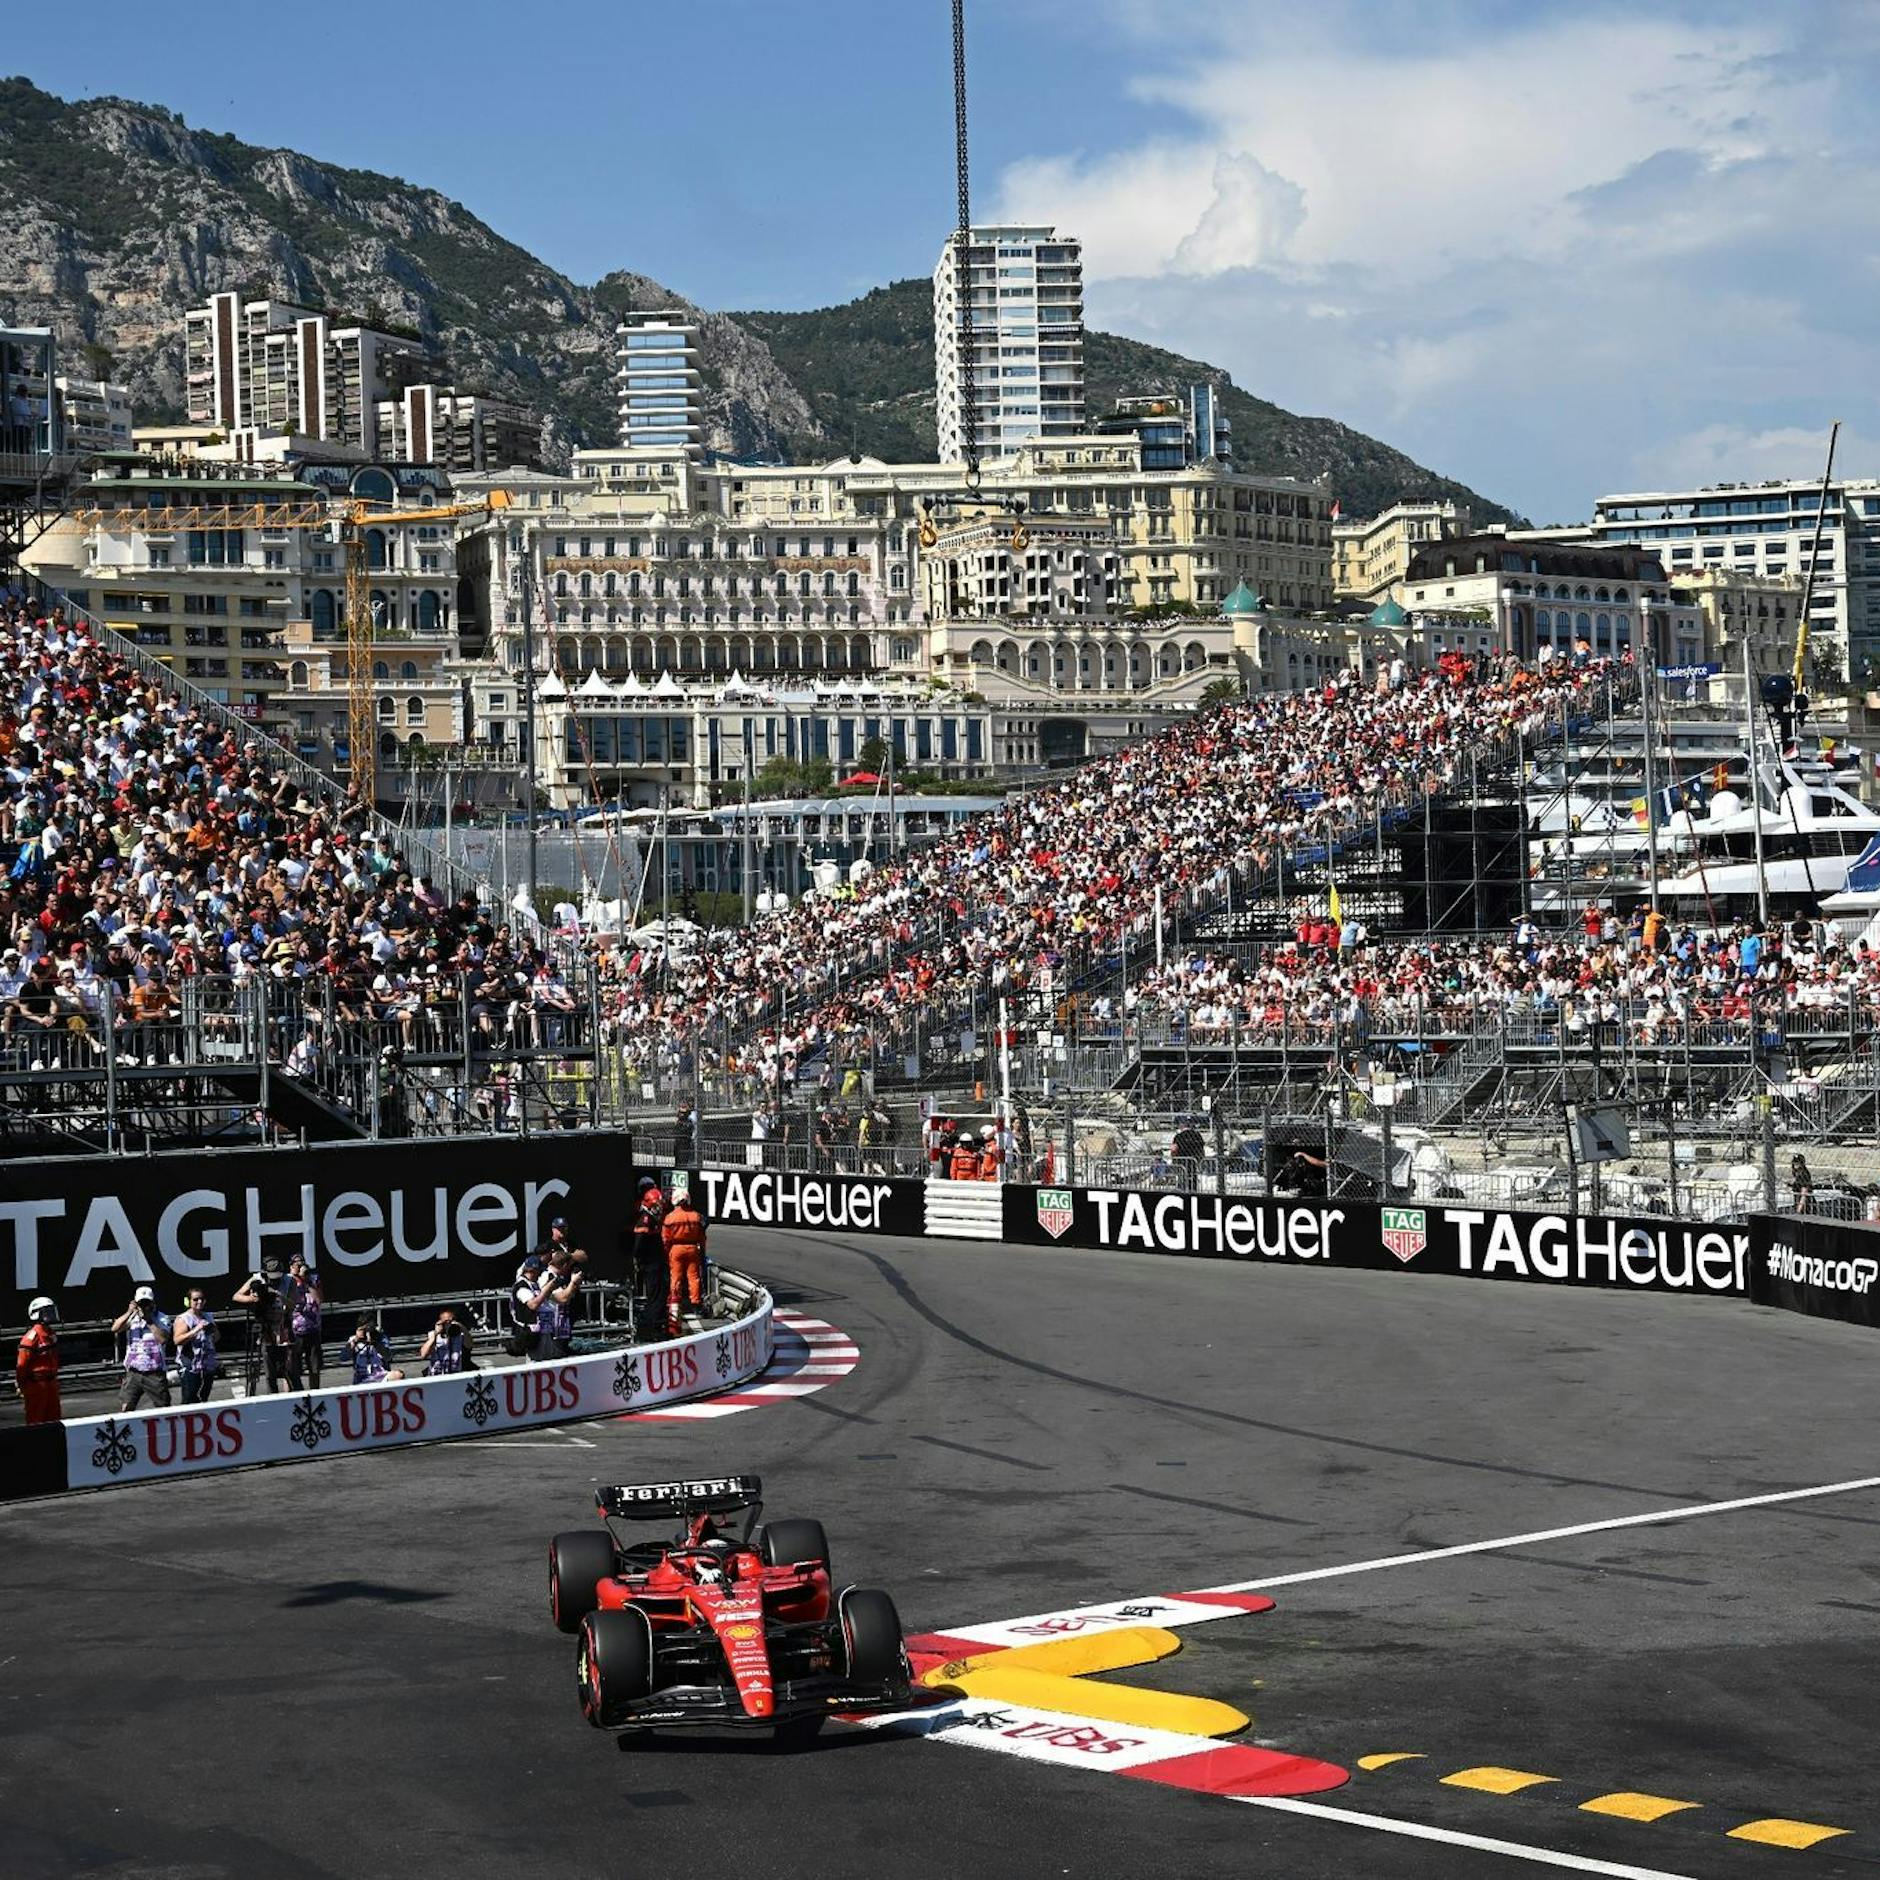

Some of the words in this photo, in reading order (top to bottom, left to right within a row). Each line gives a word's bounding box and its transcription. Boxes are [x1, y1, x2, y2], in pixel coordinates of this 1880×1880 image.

[1667, 665, 1708, 679] salesforce
[663, 1173, 687, 1187] TAG
[1040, 1193, 1070, 1209] TAG
[1040, 1211, 1071, 1235] HEUER
[1384, 1211, 1423, 1230] TAG
[1384, 1231, 1424, 1258] HEUER
[1766, 1242, 1879, 1294] #MonacoGP
[732, 1324, 757, 1371] UBS
[644, 1344, 699, 1394] UBS
[503, 1366, 581, 1417] UBS
[337, 1387, 427, 1440] UBS
[143, 1409, 243, 1466] UBS
[620, 1478, 743, 1501] Ferrari
[1006, 1615, 1138, 1636] UBS
[1001, 1721, 1147, 1754] UBS
